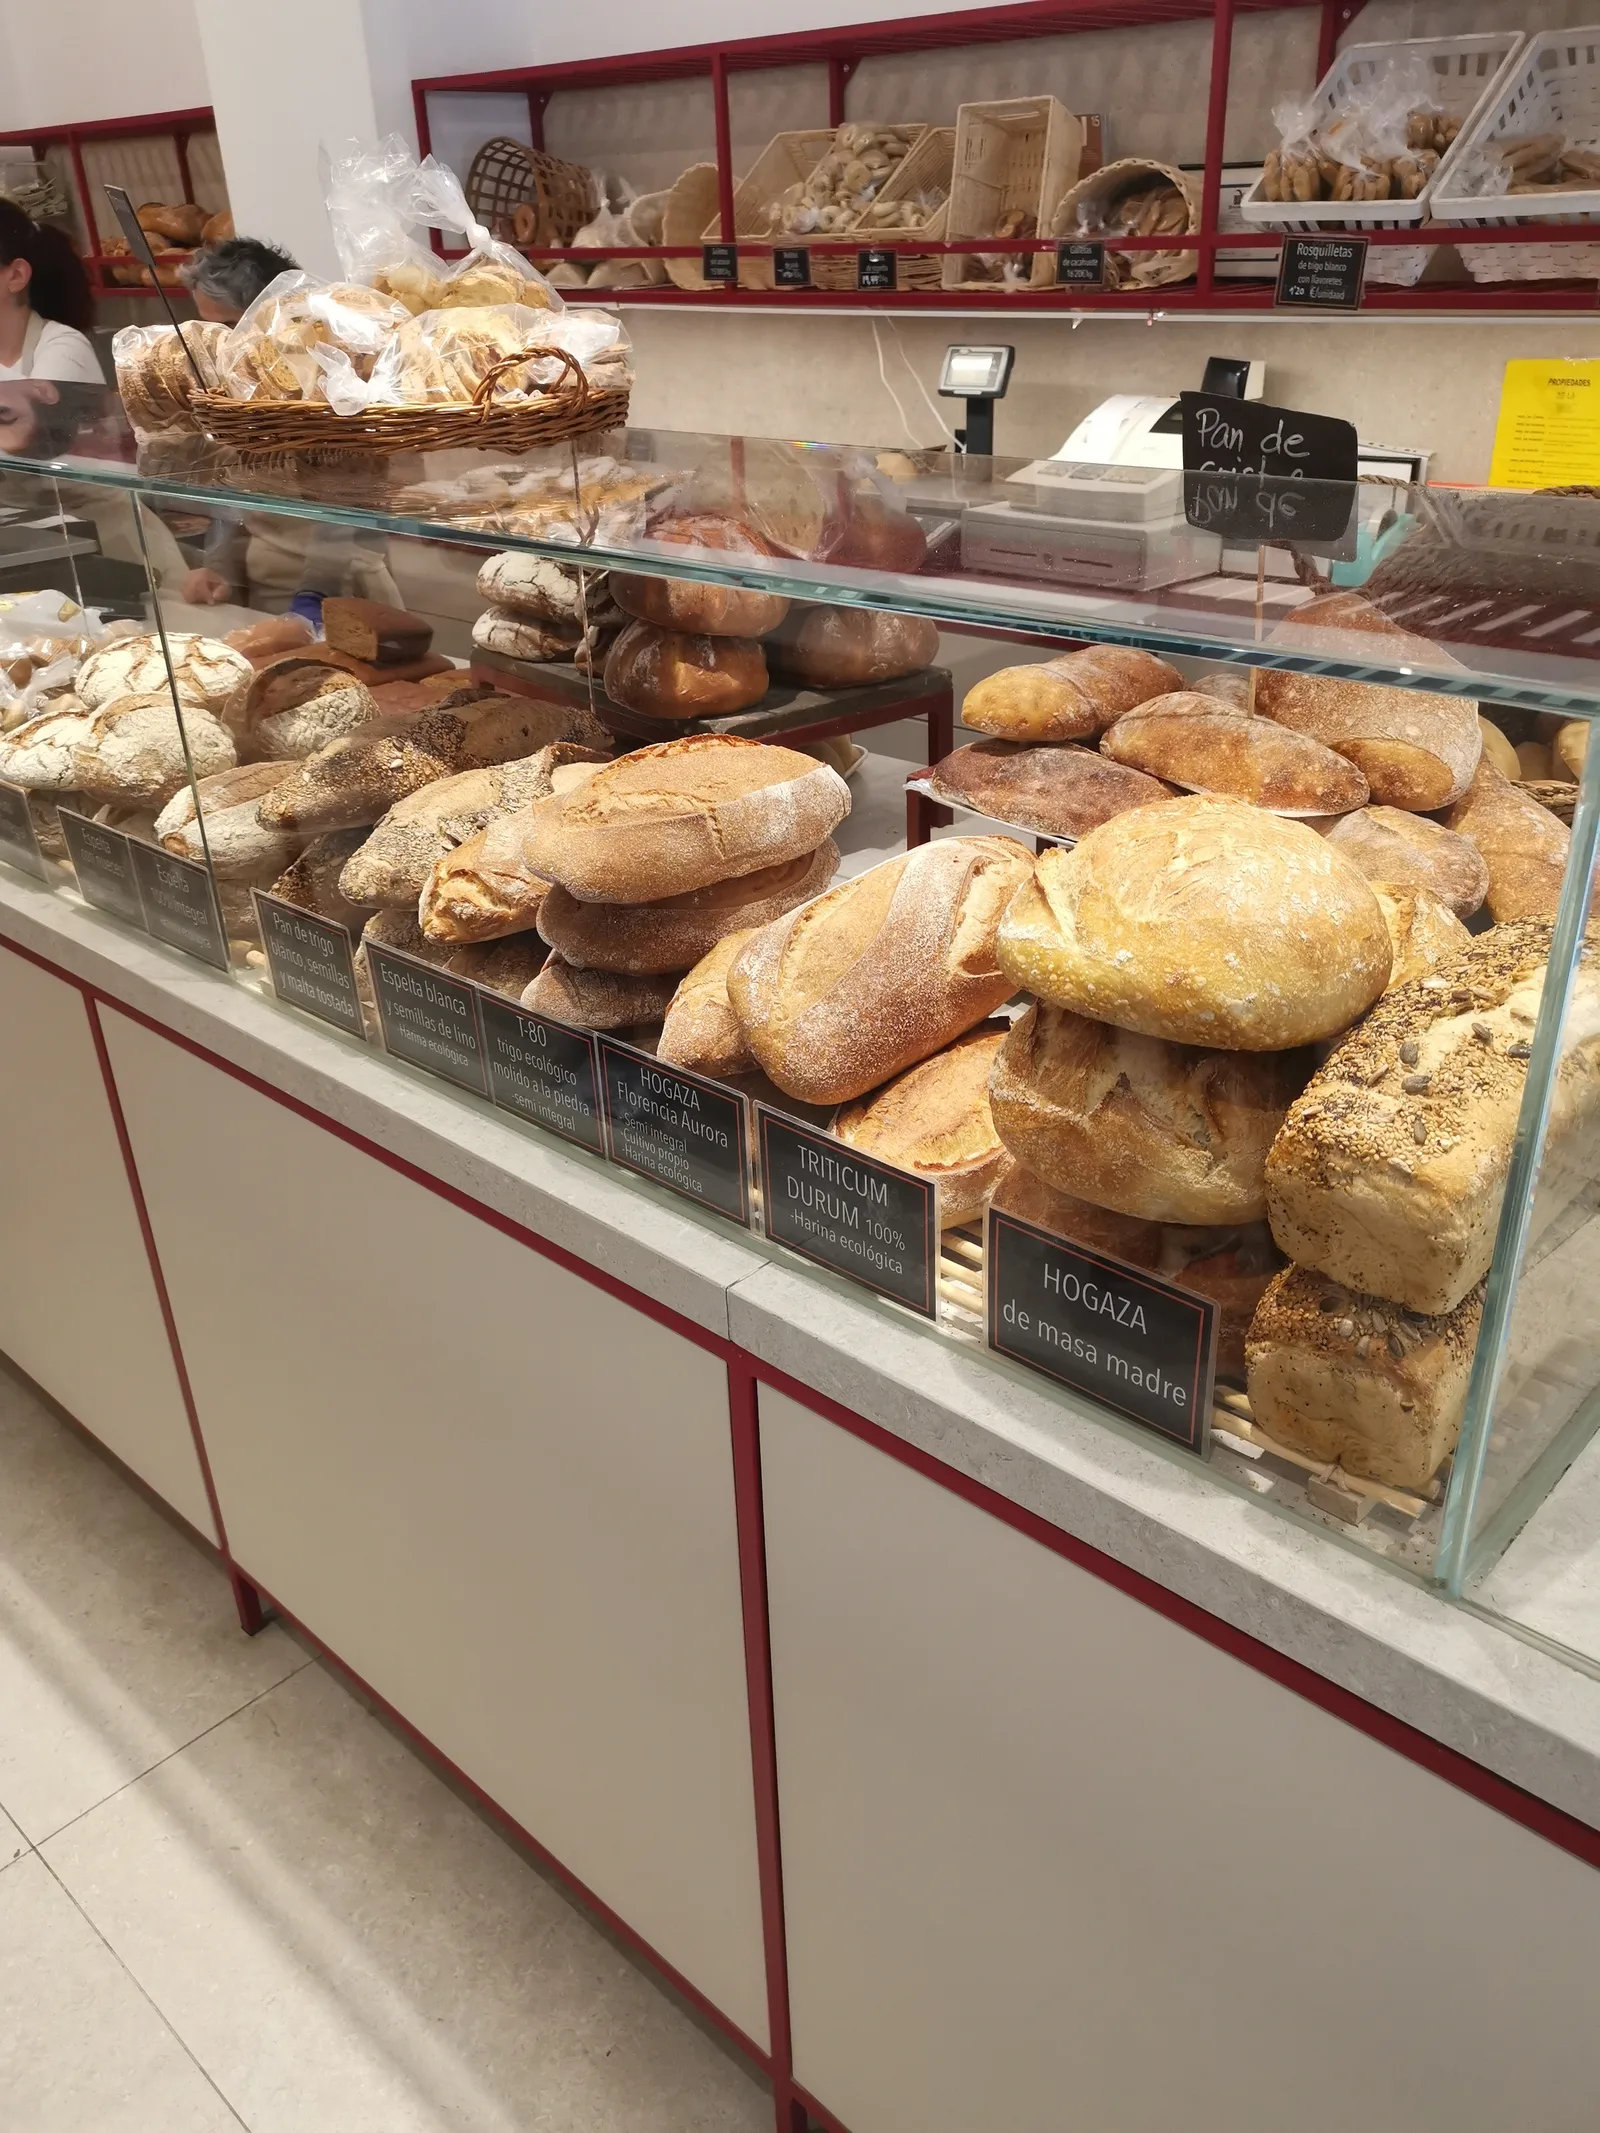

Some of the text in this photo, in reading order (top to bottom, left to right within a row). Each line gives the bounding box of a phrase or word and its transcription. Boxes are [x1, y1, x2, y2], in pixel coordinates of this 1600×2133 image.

[1297, 242, 1353, 260] Rosquilletas
[1298, 260, 1347, 272] de trigo blanco
[1298, 276, 1310, 284] con
[1547, 378, 1591, 387] PROPIEDADES
[1195, 407, 1310, 458] Pan de
[156, 864, 190, 893] Espelta
[272, 911, 334, 958] Pan de trigo
[270, 935, 350, 990] blanco, semillas
[279, 970, 356, 1018] y malta tostada
[380, 962, 467, 1017] Espelta blanca
[386, 998, 477, 1050] y semillas de lino
[516, 1015, 548, 1048] T-80
[428, 1037, 469, 1068] ecológica
[497, 1037, 578, 1086] trigo ecológico
[493, 1060, 591, 1117] molido a la piedra
[640, 1066, 701, 1112] HOGAZA
[538, 1101, 577, 1132] integral
[617, 1080, 729, 1149] Florencia Aurora
[650, 1124, 688, 1154] integral
[658, 1145, 690, 1171] propio
[657, 1162, 704, 1194] ecológica
[797, 1144, 889, 1207] TRITICUM
[787, 1174, 906, 1251] DURUM 100%
[840, 1236, 904, 1275] ecológica
[1043, 1262, 1148, 1336] HOGAZA
[1002, 1298, 1188, 1408] de masa madre
